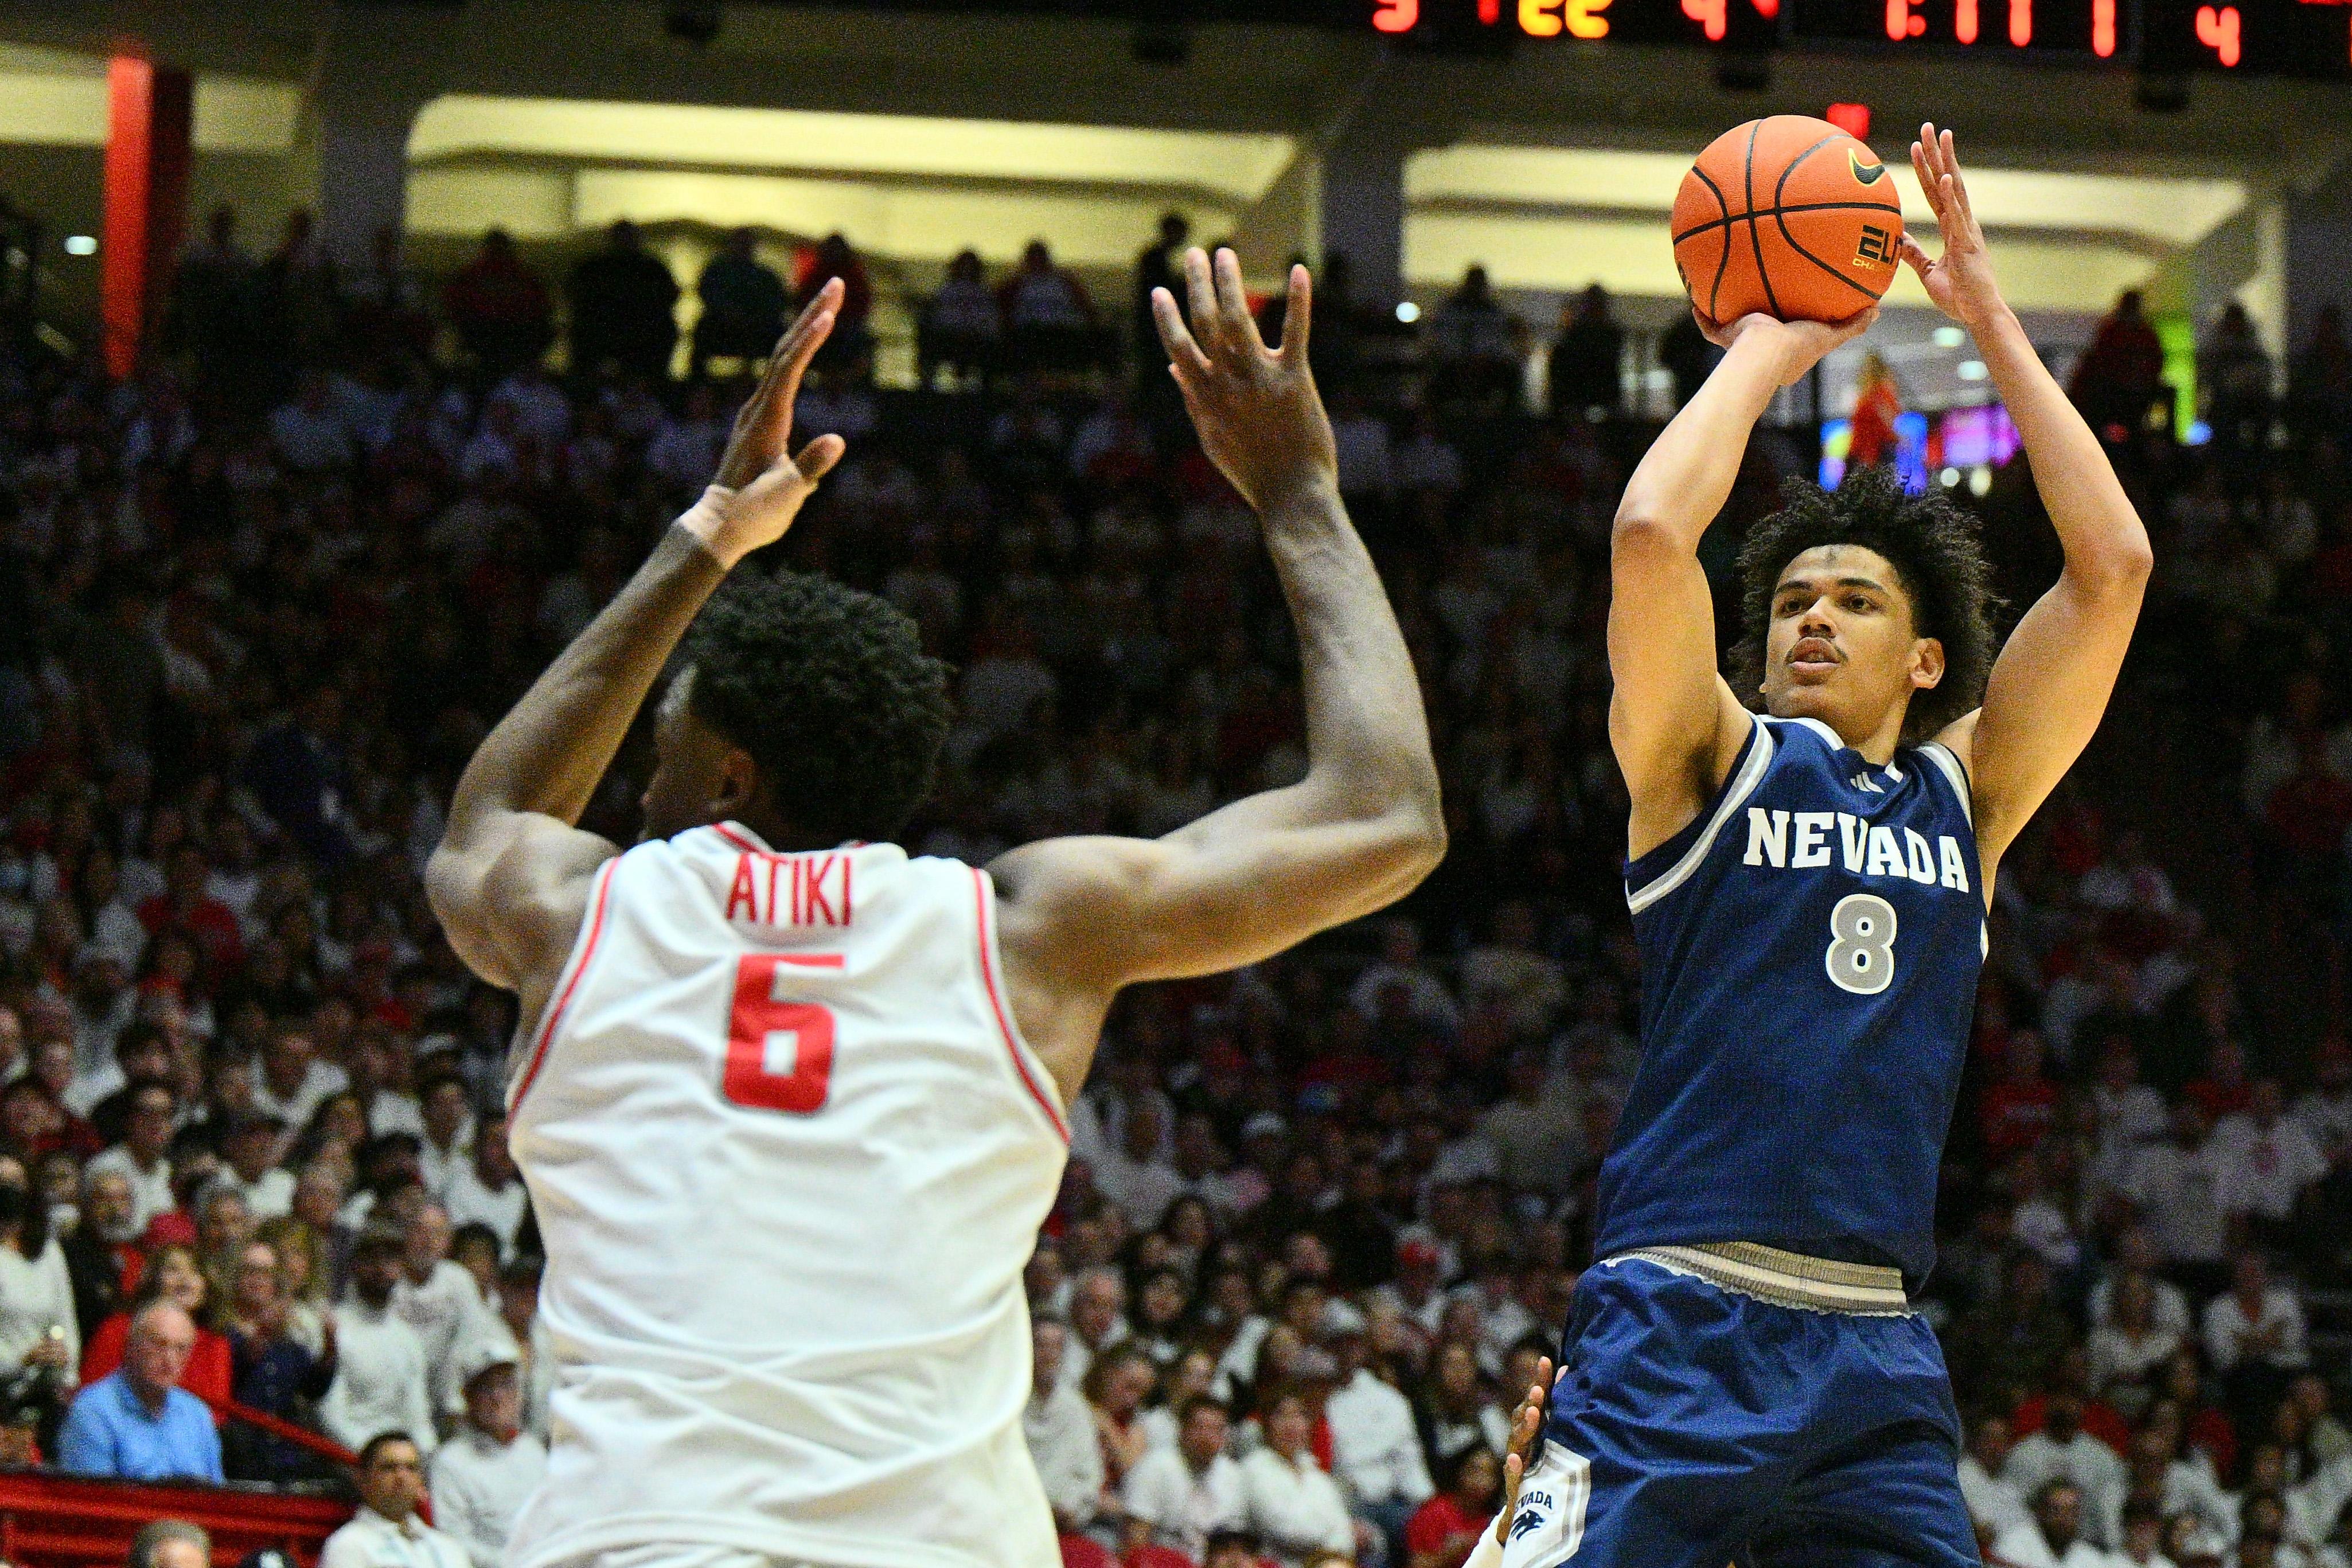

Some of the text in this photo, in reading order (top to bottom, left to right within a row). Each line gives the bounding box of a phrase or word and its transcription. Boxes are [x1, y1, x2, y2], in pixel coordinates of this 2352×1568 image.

[2196, 6, 2240, 67] 4
[726, 853, 852, 927] ATIKI
[1743, 807, 1969, 894] NEVADA
[1826, 893, 1897, 995] 8
[722, 953, 846, 1114] 6
